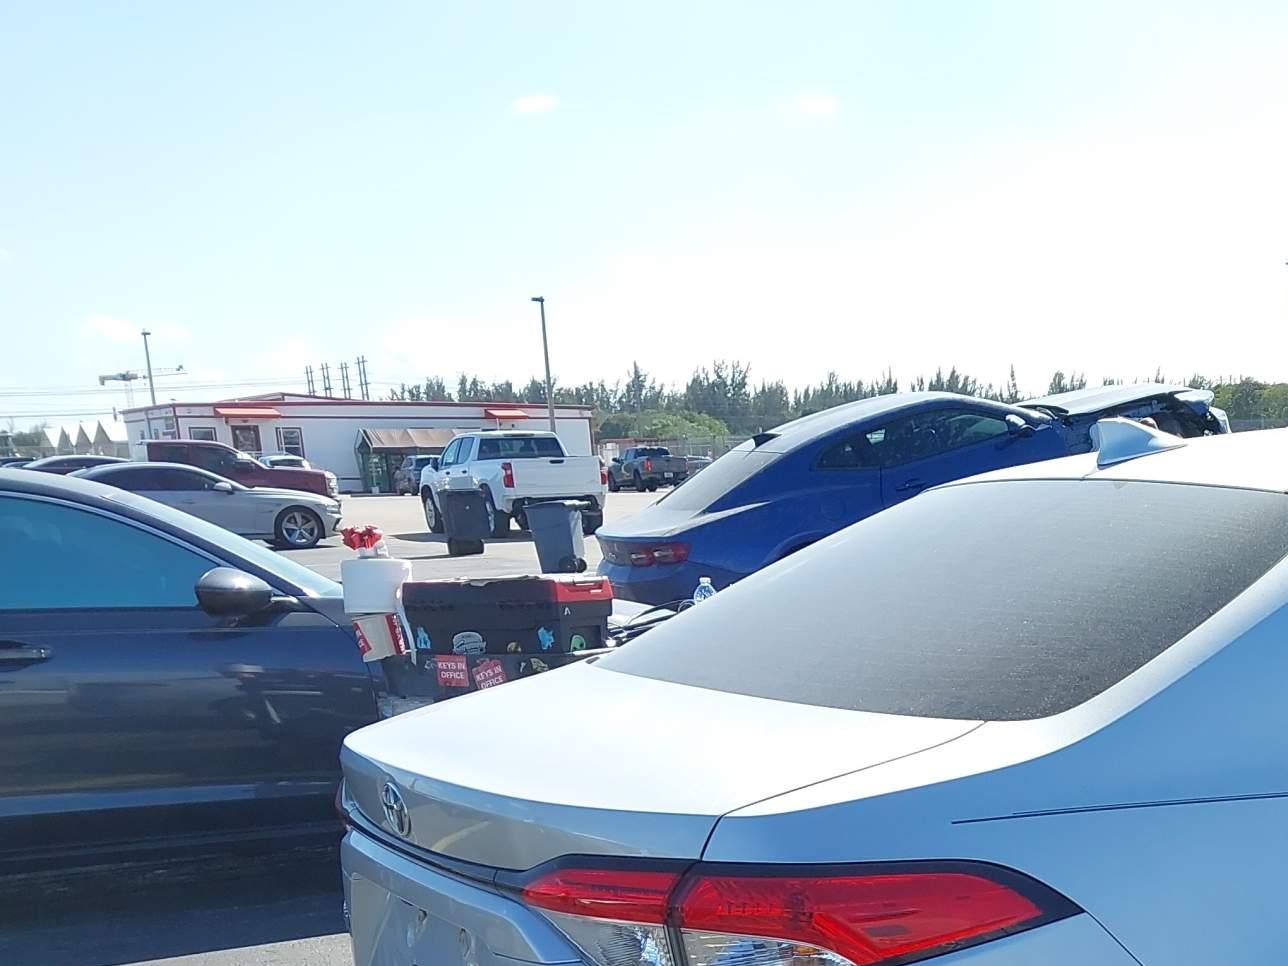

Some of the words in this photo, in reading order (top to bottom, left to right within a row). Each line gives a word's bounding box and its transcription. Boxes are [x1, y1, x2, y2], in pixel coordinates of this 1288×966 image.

[438, 662, 456, 670] KEYS
[457, 661, 465, 670] IN
[440, 671, 465, 679] OFFICE
[476, 669, 493, 681] KEYS
[493, 664, 502, 673] IN
[481, 675, 504, 689] OFFICE
